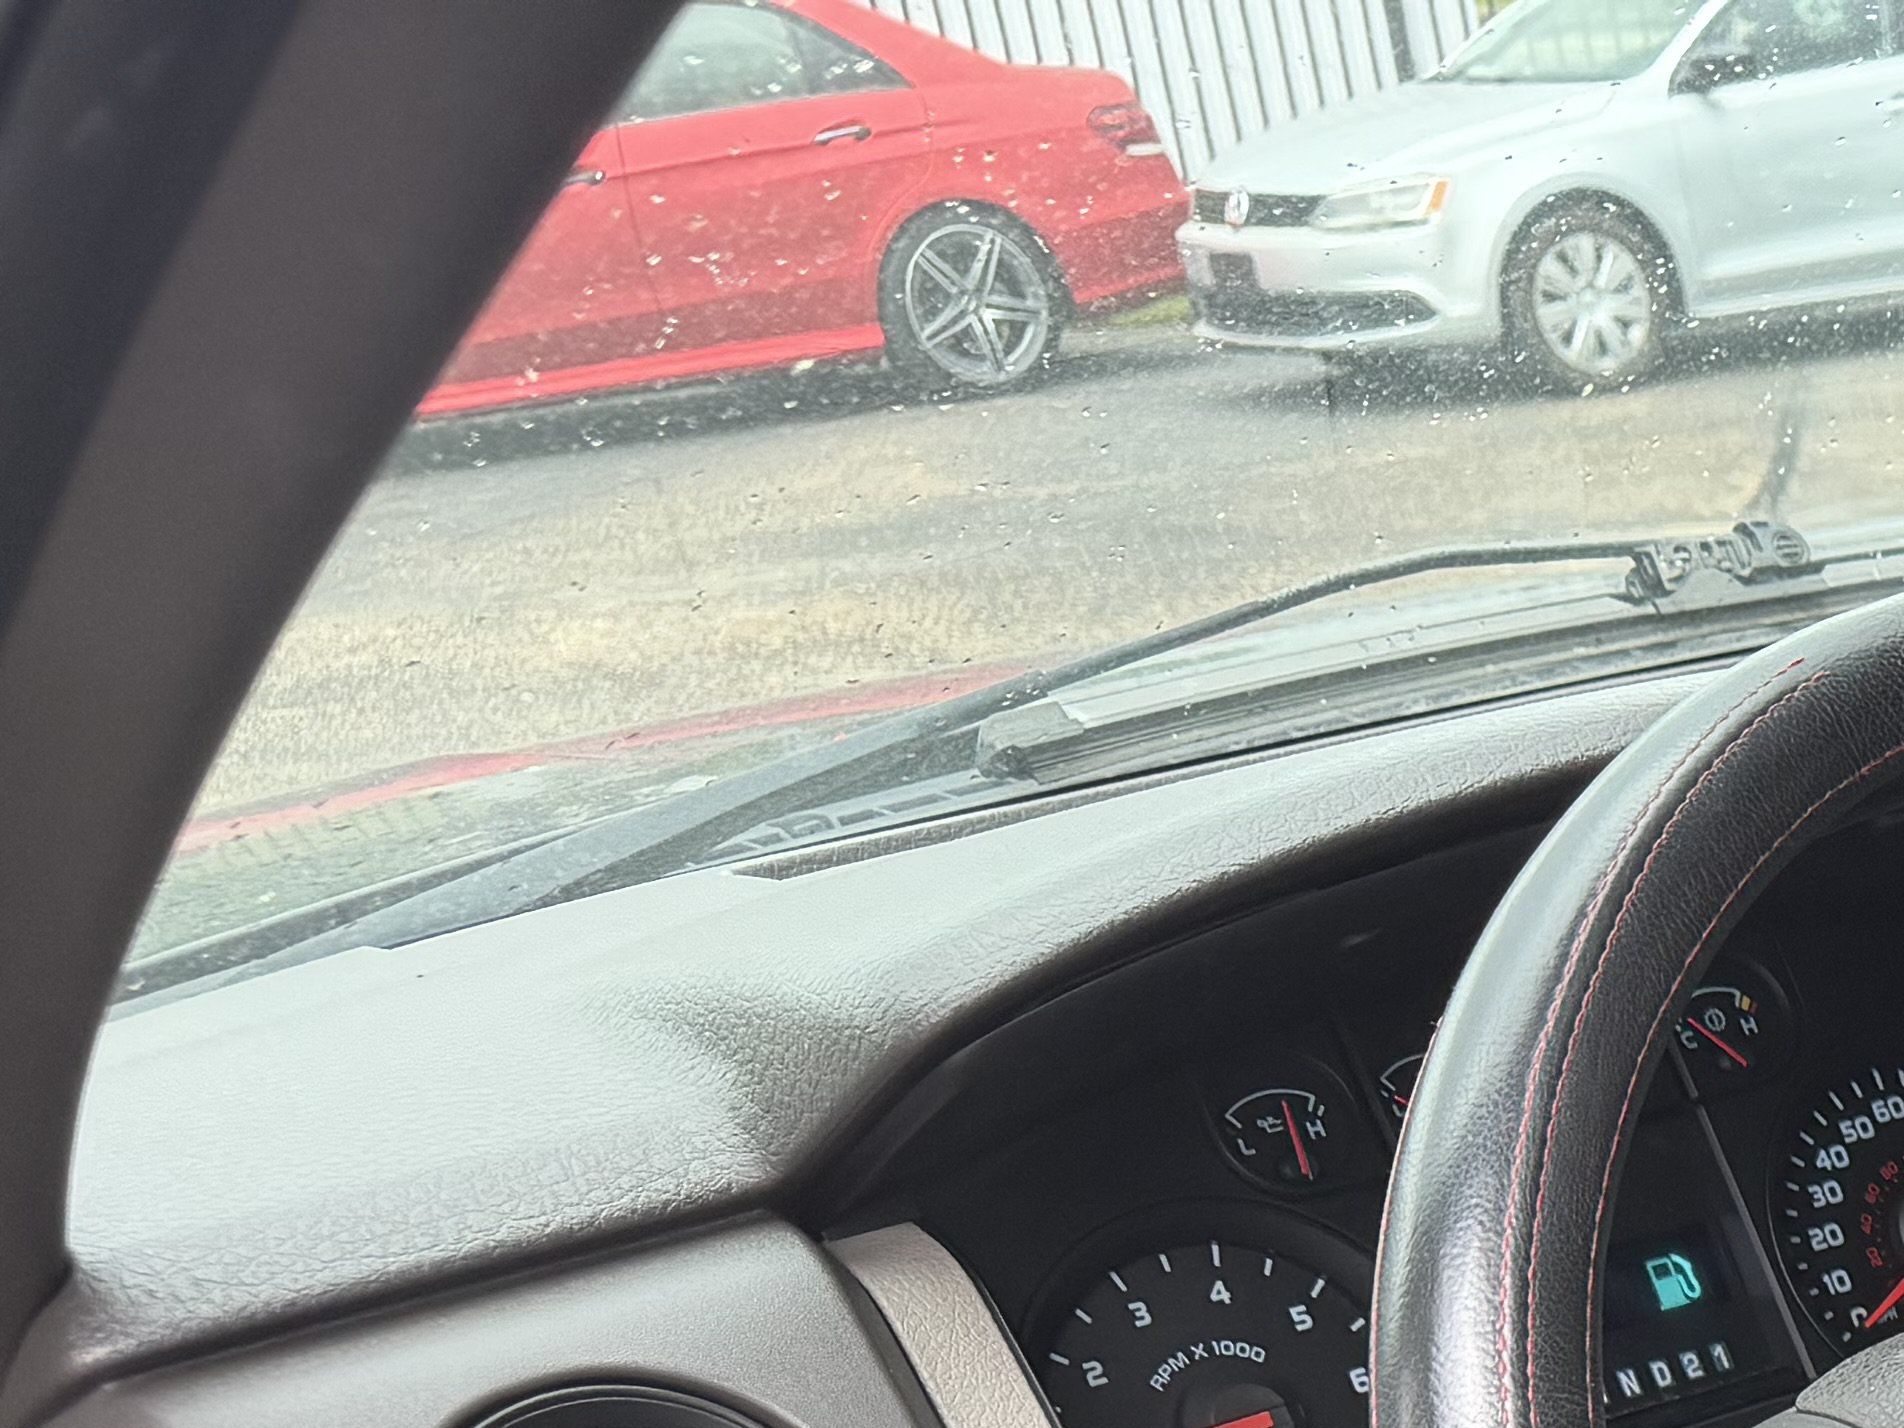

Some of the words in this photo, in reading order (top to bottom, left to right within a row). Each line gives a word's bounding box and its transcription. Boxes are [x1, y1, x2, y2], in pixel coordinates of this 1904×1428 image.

[1740, 1016, 1758, 1036] H
[1680, 1031, 1698, 1049] C
[1306, 1118, 1327, 1140] H
[1838, 1115, 1875, 1143] 50
[1237, 1138, 1256, 1156] L
[1815, 1144, 1850, 1171] 40
[1807, 1179, 1844, 1208] 30
[1808, 1222, 1845, 1251] 20
[1210, 1279, 1232, 1304] 4
[1822, 1268, 1852, 1296] 10
[1127, 1301, 1152, 1327] 3
[1289, 1304, 1314, 1331] 5
[1082, 1361, 1109, 1388] 2
[1150, 1351, 1190, 1392] RPM
[1191, 1342, 1209, 1360] X
[1211, 1340, 1266, 1363] 1000
[1616, 1367, 1643, 1398] N
[1649, 1359, 1674, 1388] D
[1679, 1351, 1705, 1380] 2
[1710, 1342, 1731, 1370] 1
[1350, 1367, 1369, 1393] 6
